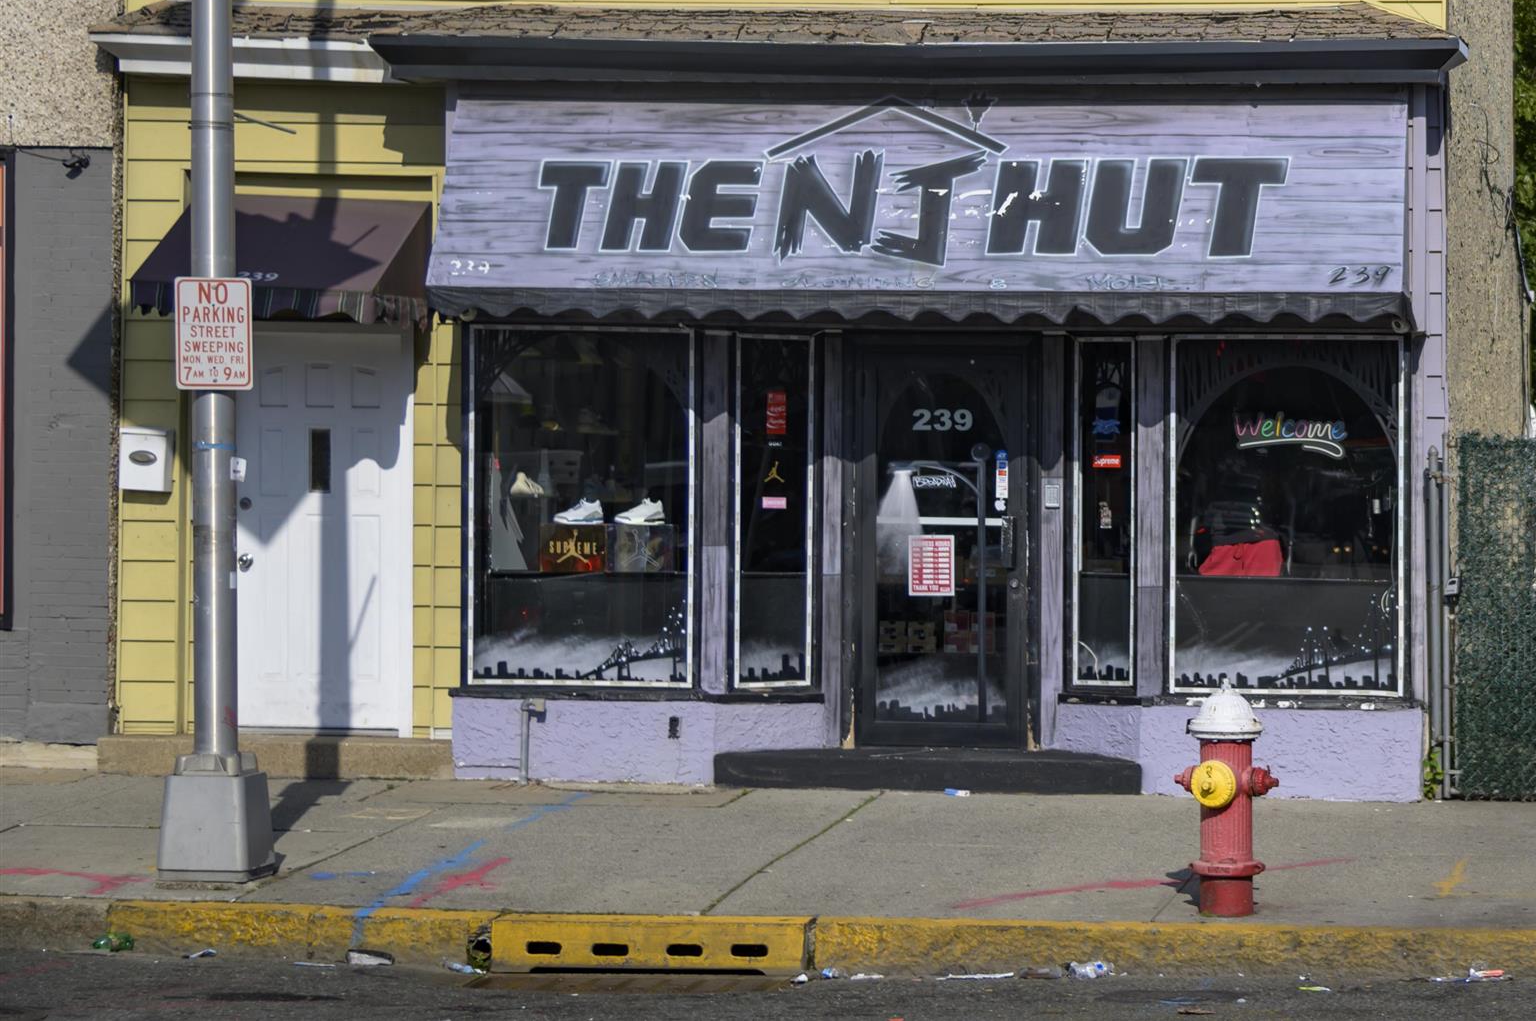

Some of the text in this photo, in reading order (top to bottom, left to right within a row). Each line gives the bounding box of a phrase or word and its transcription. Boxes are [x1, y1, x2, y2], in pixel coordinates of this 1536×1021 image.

[537, 158, 766, 253] THE
[984, 156, 1292, 260] HUT
[1327, 264, 1392, 288] 239
[198, 281, 229, 305] NO
[182, 306, 245, 324] PARKING
[190, 325, 236, 339] STREET
[184, 340, 244, 354] SWEEPING
[209, 369, 219, 378] TO
[912, 408, 974, 431] 239
[1234, 411, 1348, 441] Welcome
